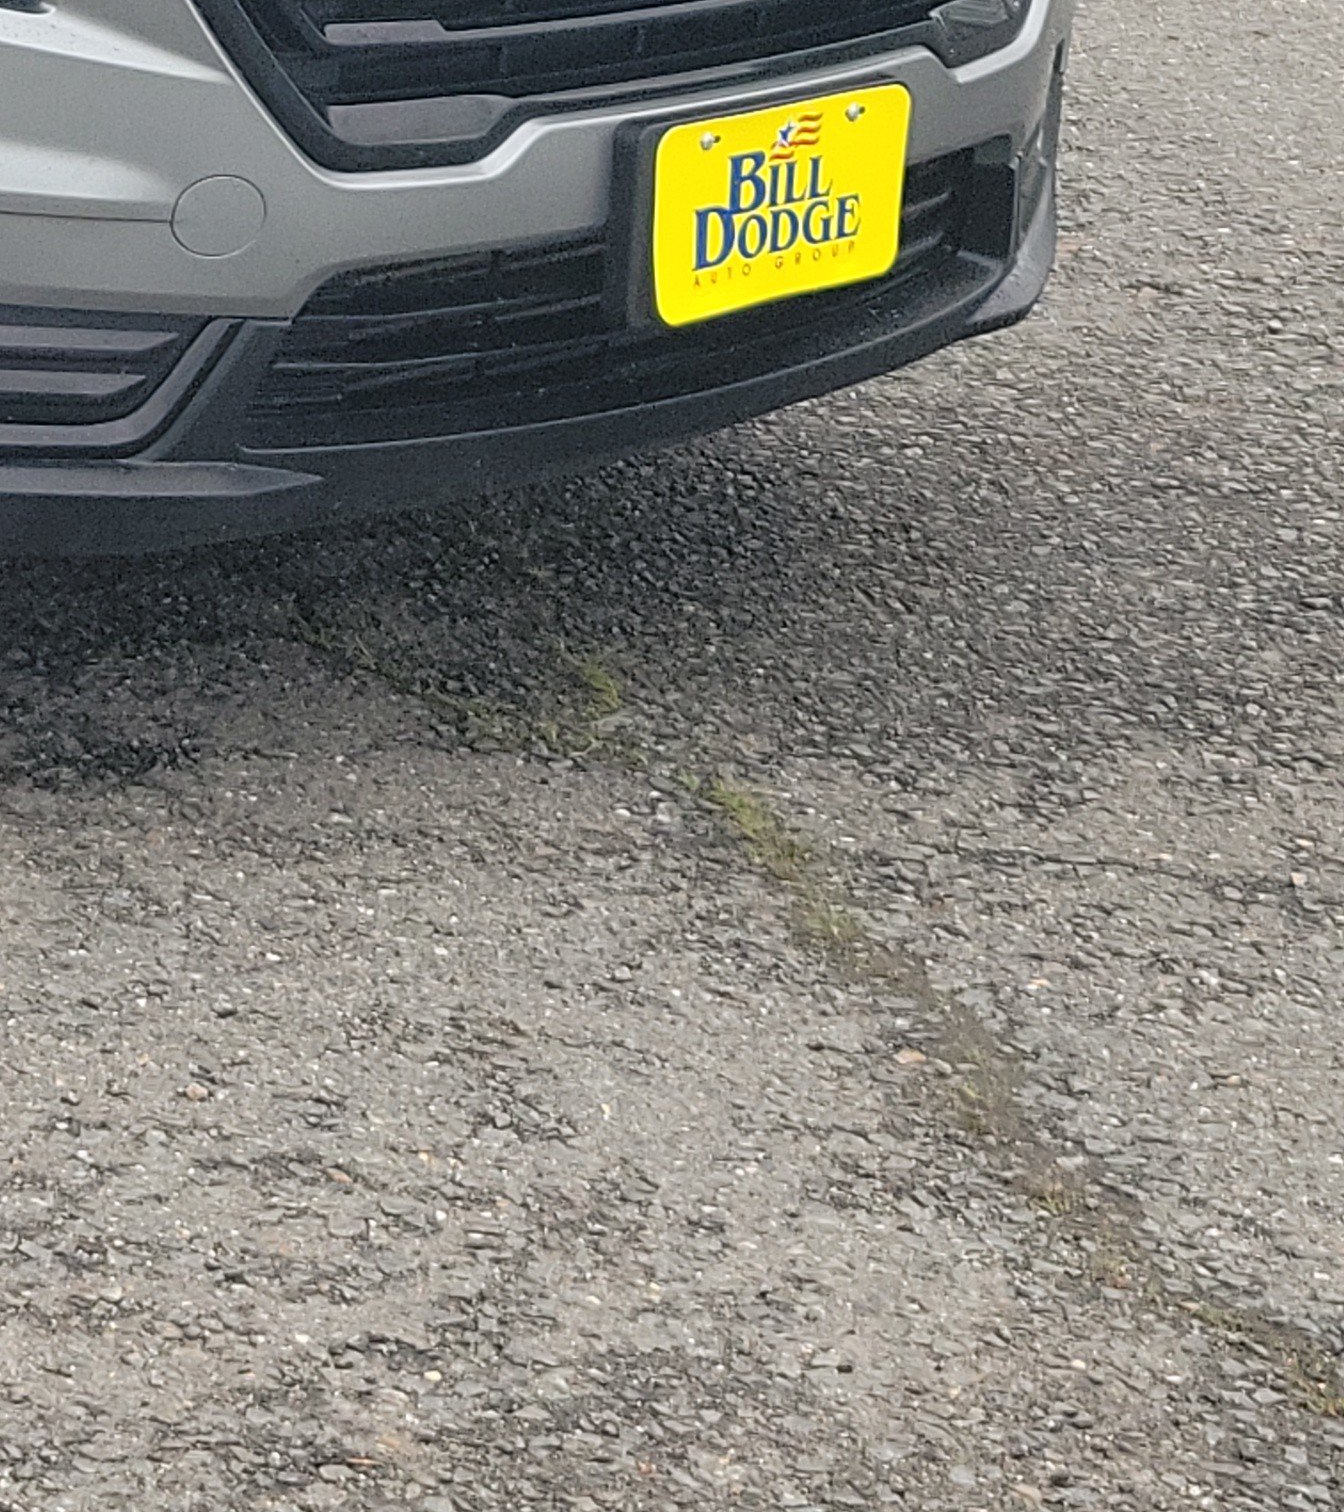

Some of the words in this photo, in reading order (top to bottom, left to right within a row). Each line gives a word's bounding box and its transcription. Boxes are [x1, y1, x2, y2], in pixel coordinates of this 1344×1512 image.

[728, 150, 833, 216] BILL
[691, 193, 862, 272] DODGE
[693, 263, 752, 288] AUTO
[774, 240, 855, 270] GROUP
